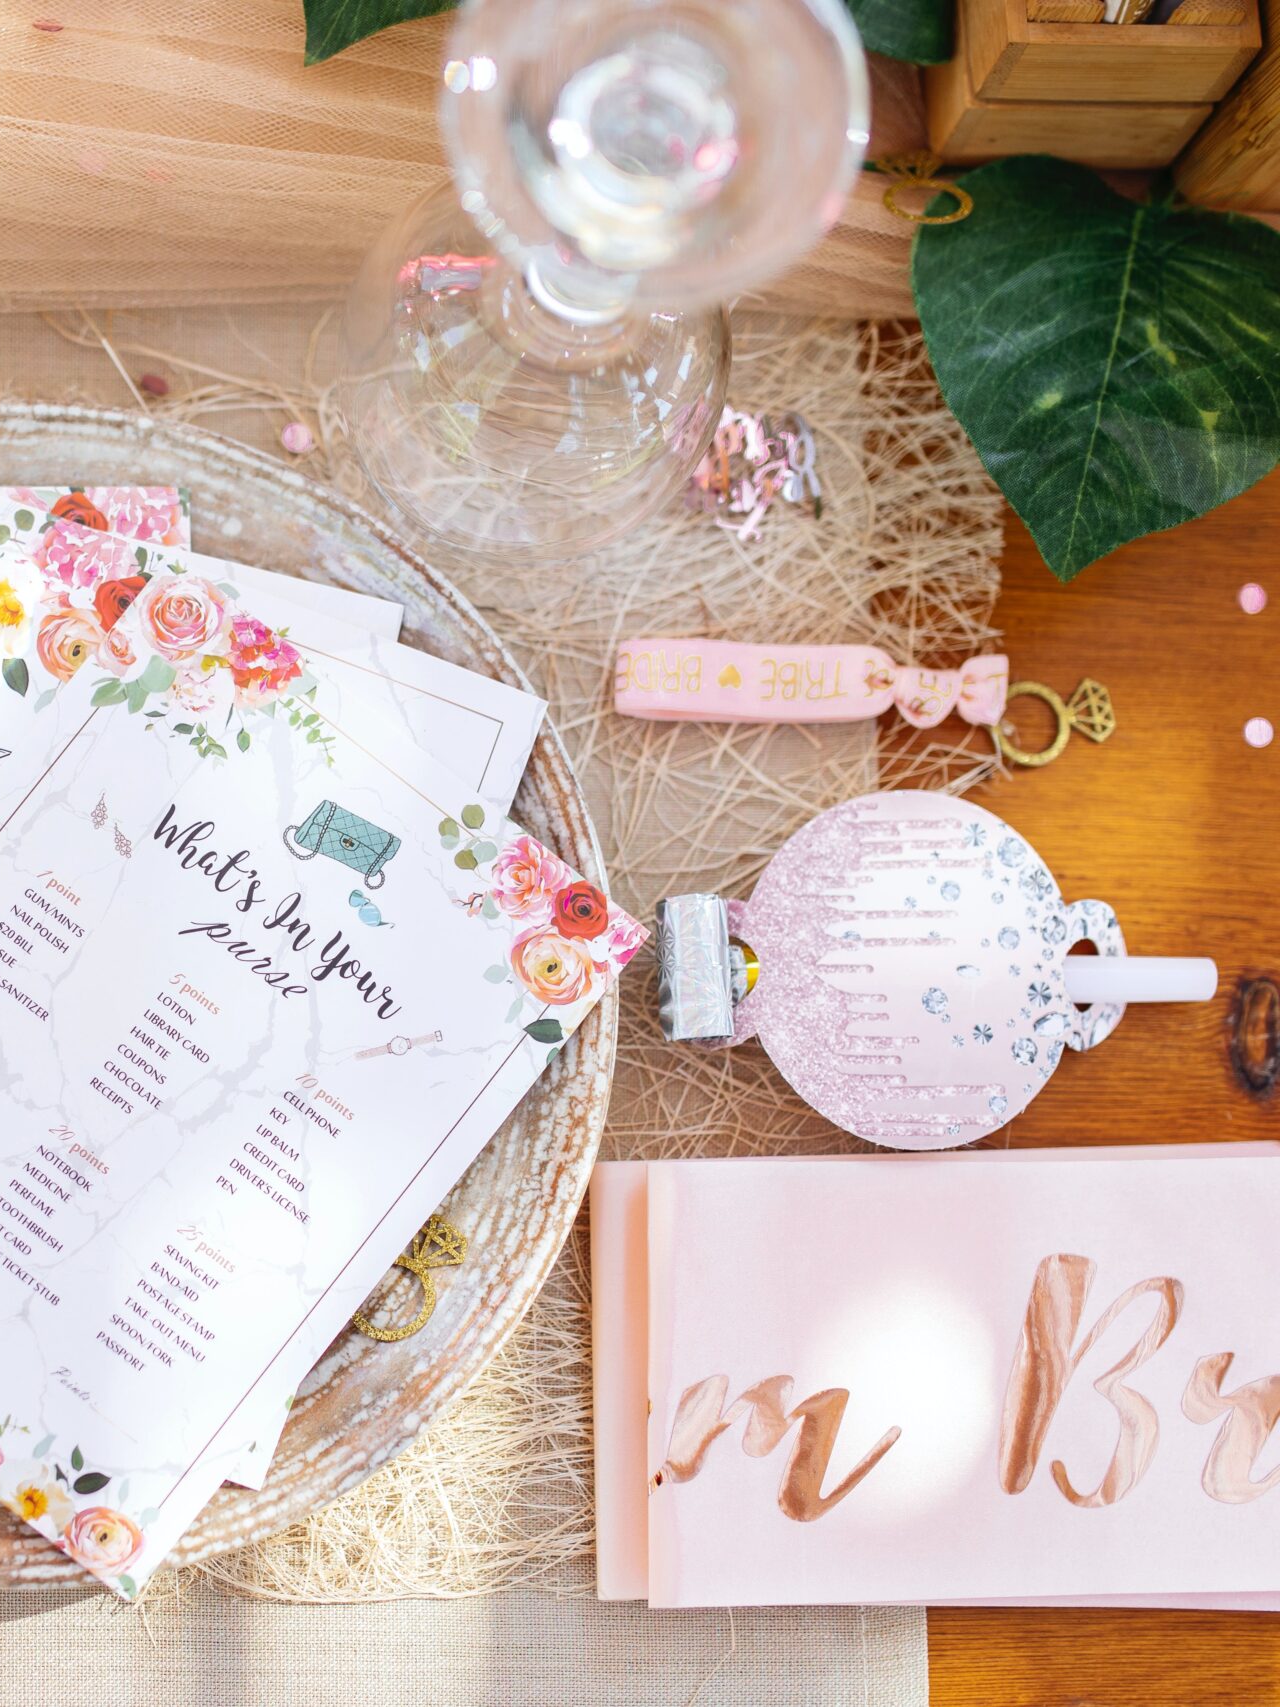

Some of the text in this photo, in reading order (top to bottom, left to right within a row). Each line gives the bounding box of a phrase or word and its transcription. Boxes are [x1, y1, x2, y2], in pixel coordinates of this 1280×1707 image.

[616, 649, 702, 694] BRIDE
[760, 657, 848, 701] TRIBE
[24, 888, 85, 938] GUM/MINTS
[45, 878, 81, 906] point
[153, 803, 402, 1020] What's In Your
[10, 904, 70, 954] NAIL POLISH
[13, 934, 34, 955] BILL
[178, 921, 308, 999] purse
[0, 979, 49, 1022] SANITIZER
[157, 992, 197, 1026] LOTION
[169, 973, 220, 1015] 5 points
[130, 1025, 171, 1061] HAIR TIE
[143, 1008, 210, 1063] LIBRARY CARD
[104, 1061, 163, 1110] CHOCOLATE
[117, 1044, 167, 1085] COUPONS
[89, 1077, 134, 1114] RECEIPTS
[269, 1107, 290, 1125] KEY
[283, 1091, 341, 1139] CELL PHONE
[295, 1073, 355, 1121] 10 points
[48, 1125, 110, 1175] 20 points
[256, 1124, 300, 1162] LIP BALM
[23, 1162, 72, 1202] MEDICINE
[36, 1145, 93, 1192] NOTEBOOK
[216, 1175, 237, 1195] PEN
[243, 1142, 305, 1192] CREDIT CARD
[9, 1179, 55, 1217] PERFUME
[229, 1158, 310, 1224] DRIVER'S LICENSE
[3, 1231, 32, 1255] CARD
[176, 1225, 236, 1273] 25 points
[2, 1257, 35, 1285] TICKET
[33, 1282, 60, 1306] STUB
[150, 1262, 199, 1302] BAND-AID
[163, 1245, 219, 1290] SEWING KIT
[137, 1279, 215, 1340] POSTAGE STAMP
[96, 1331, 145, 1372] PASSPORT
[173, 1335, 206, 1362] MENU
